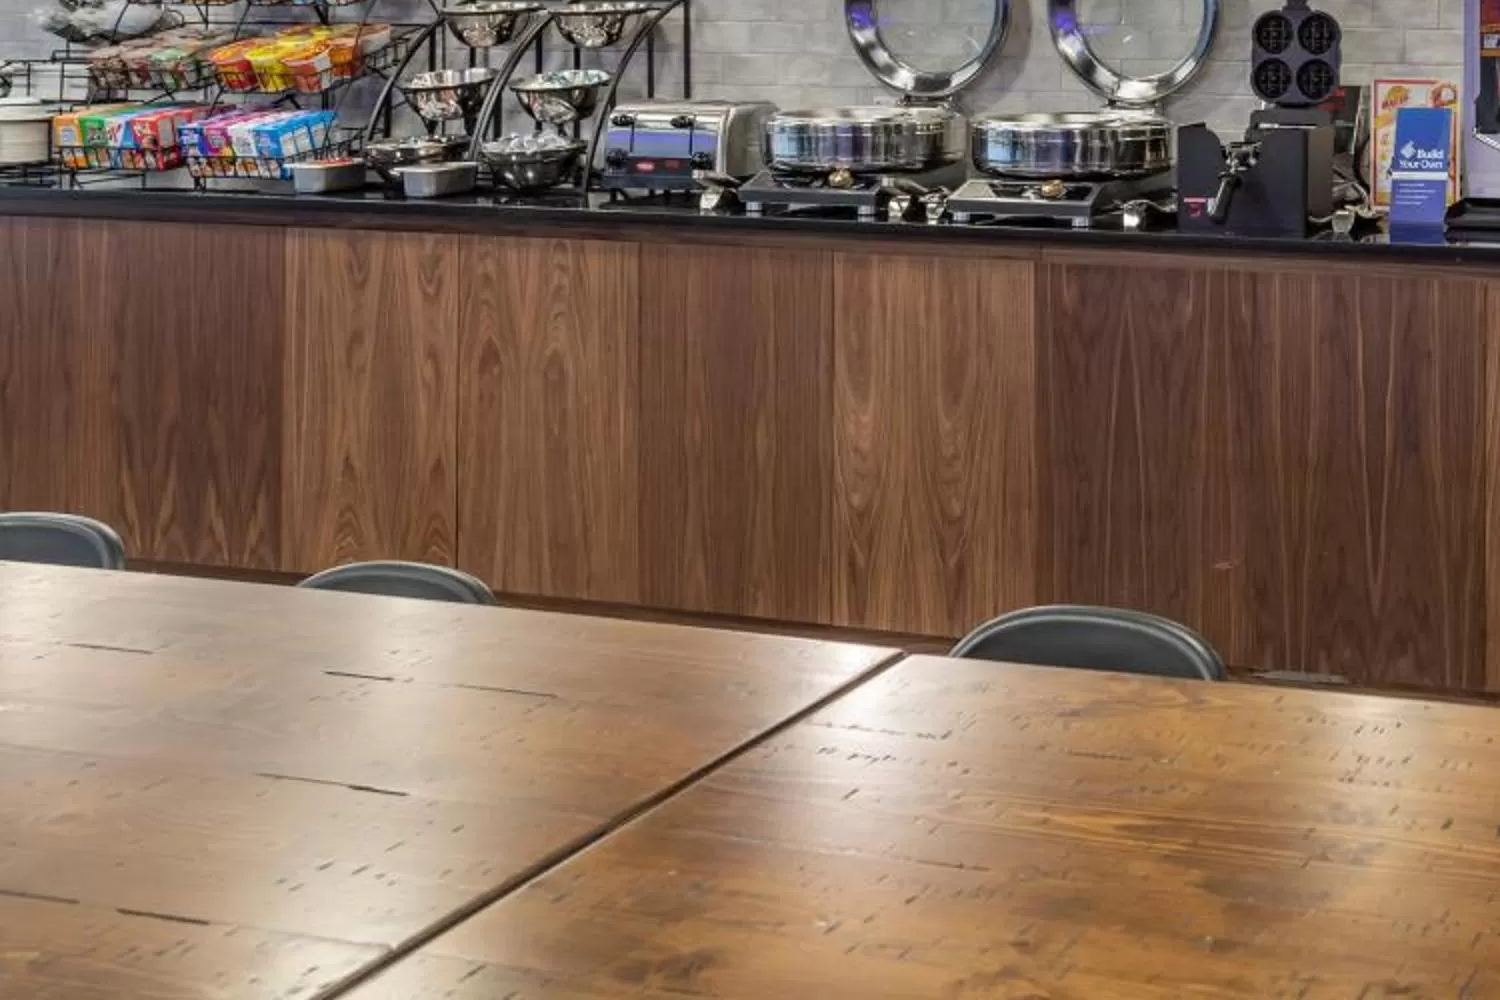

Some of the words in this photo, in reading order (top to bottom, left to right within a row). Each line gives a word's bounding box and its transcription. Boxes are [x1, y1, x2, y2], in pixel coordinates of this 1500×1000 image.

[1416, 148, 1445, 159] Build
[1399, 160, 1420, 169] Your
[1421, 159, 1443, 169] Own
